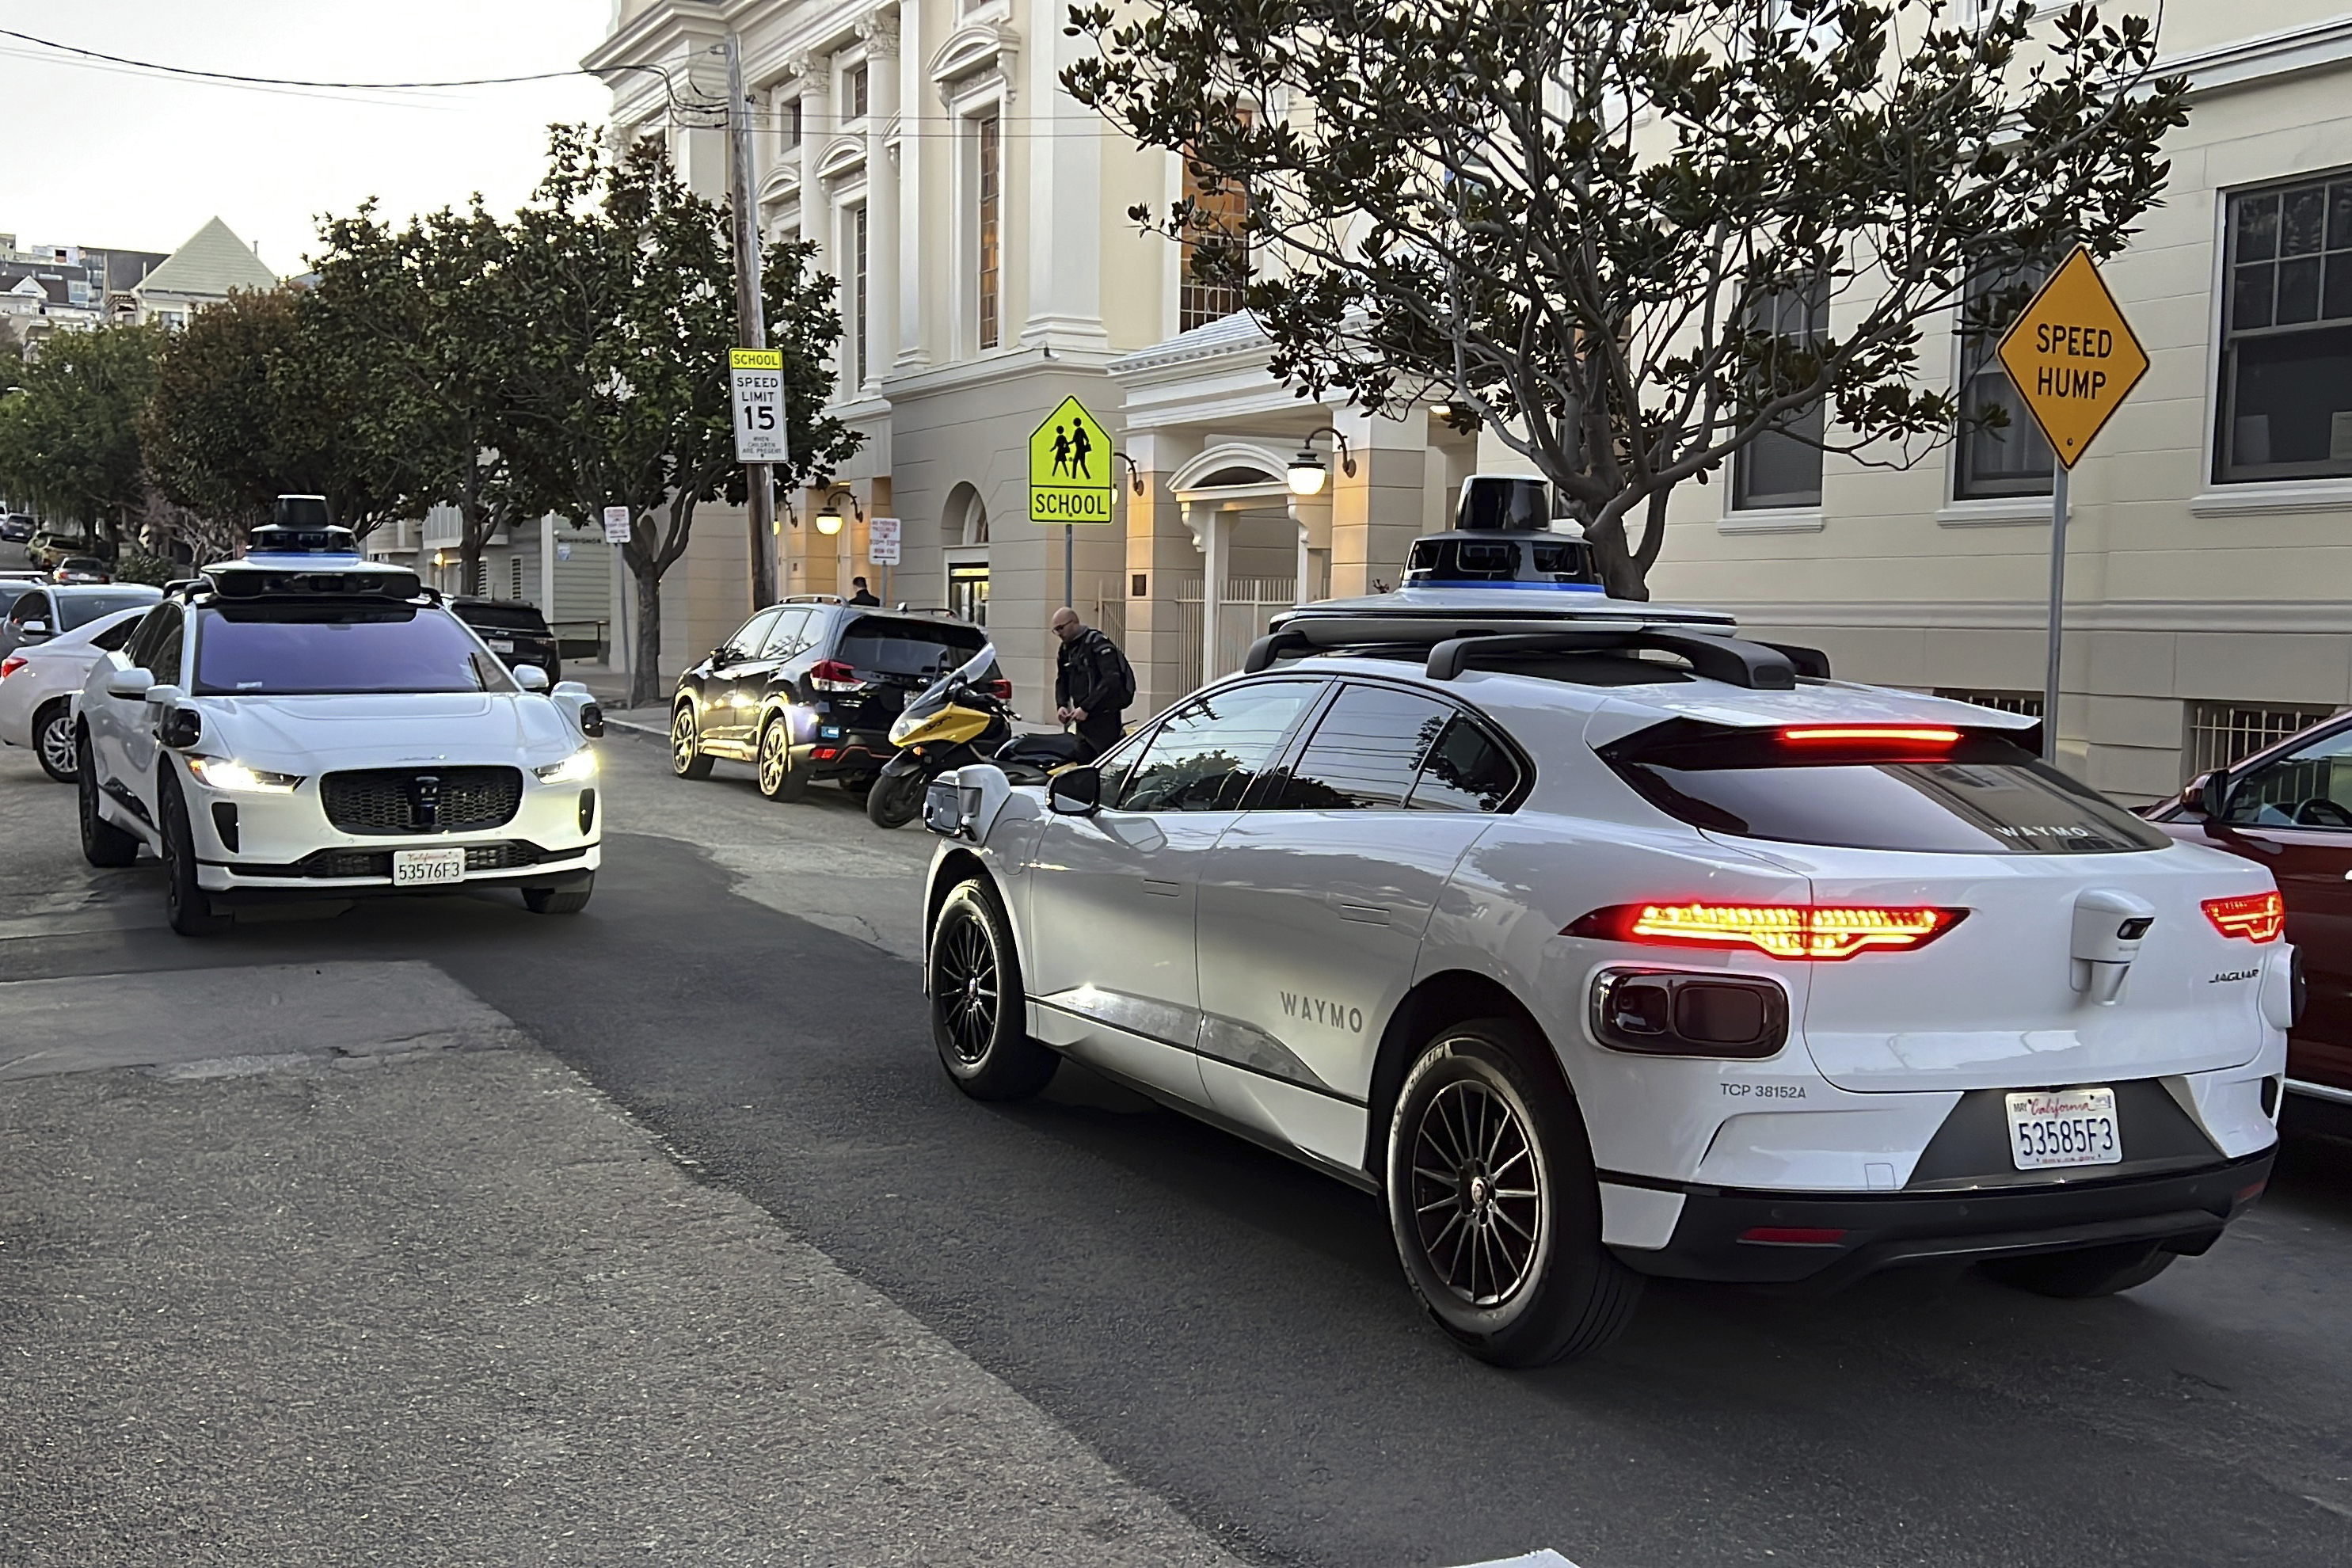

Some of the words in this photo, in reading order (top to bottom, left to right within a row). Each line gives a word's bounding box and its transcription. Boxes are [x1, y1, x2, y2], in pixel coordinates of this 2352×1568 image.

[2037, 323, 2112, 358] SPEED
[733, 354, 778, 366] SCHOOL
[737, 378, 778, 387] SPEED
[2038, 367, 2107, 400] HUMP
[742, 392, 774, 402] LIMIT
[744, 406, 775, 430] 15
[1035, 493, 1106, 514] SCHOOL
[1994, 826, 2089, 837] WAYMO
[399, 862, 459, 880] 53576F3
[2208, 969, 2259, 983] JAGUAR
[1280, 991, 1363, 1033] WAYMO
[1720, 1083, 1751, 1096] TCP
[1755, 1085, 1806, 1099] 38152A
[2013, 1103, 2027, 1113] MAY
[2030, 1098, 2096, 1118] California
[2019, 1117, 2113, 1156] 53585F3
